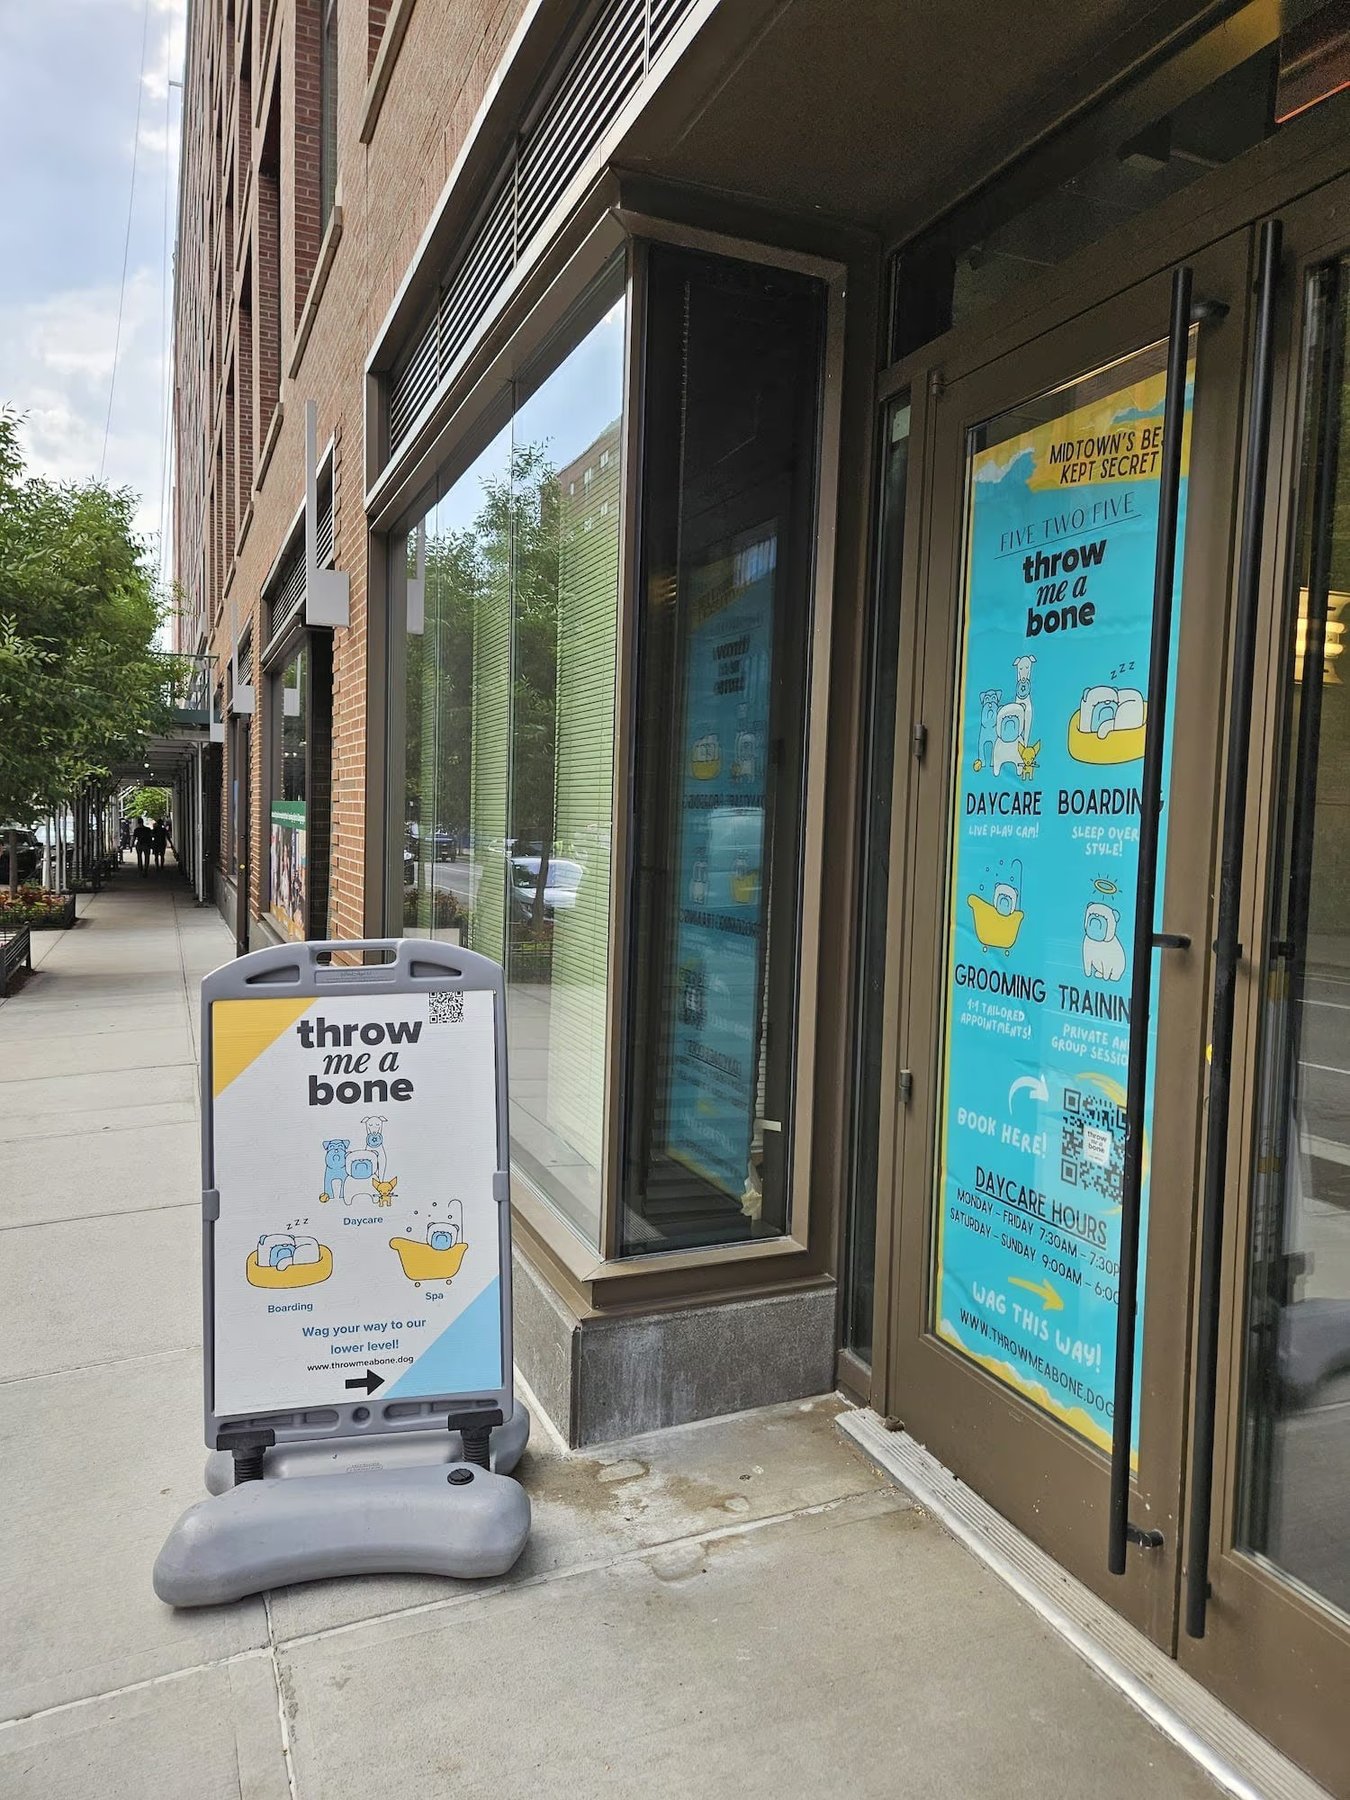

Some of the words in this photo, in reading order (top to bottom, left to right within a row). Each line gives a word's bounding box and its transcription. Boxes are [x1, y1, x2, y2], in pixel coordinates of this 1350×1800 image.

[1050, 431, 1135, 464] MIDTOWN'S
[1141, 426, 1165, 450] BE
[1060, 460, 1095, 484] KEPT
[1100, 451, 1159, 479] SECRET
[1000, 524, 1036, 551] FIVE
[1042, 508, 1085, 538] TWO
[1092, 491, 1135, 523] FIVE
[1022, 539, 1107, 584] throw
[1036, 579, 1066, 606] me
[1072, 575, 1087, 599] a
[1025, 601, 1096, 637] bone
[967, 791, 1042, 815] DAYCARE
[1058, 788, 1164, 815] BOARDIN
[969, 824, 987, 837] LIVE
[990, 824, 1012, 838] PLAY
[1016, 822, 1039, 838] CAM!
[1072, 826, 1104, 840] SLEEP
[1085, 840, 1122, 856] STYLE!
[955, 964, 1046, 1003] GROOMING
[982, 1003, 1025, 1022] TAILORED
[1059, 985, 1132, 1024] TRAININ
[297, 1017, 422, 1049] throw
[960, 1013, 1031, 1040] APPOINTMENTS!
[1063, 1024, 1108, 1045] PRIVATE
[1112, 1036, 1130, 1051] AN
[322, 1052, 370, 1075] me
[379, 1051, 399, 1072] a
[1052, 1036, 1087, 1057] GROUP
[1091, 1047, 1128, 1066] SESSIO
[308, 1075, 414, 1106] bone
[957, 1107, 996, 1136] BOOK
[1002, 1124, 1048, 1159] HERE!
[976, 1166, 1046, 1218] DAYCARE
[1052, 1200, 1107, 1246] HOURS
[343, 1216, 384, 1227] Daycare
[957, 1188, 995, 1216] MONDAY
[1003, 1210, 1034, 1233] FRIDAY
[1039, 1227, 1078, 1258] 7:30AM
[1090, 1251, 1120, 1277] 7:30P
[950, 1207, 992, 1238] SATURDAY
[1001, 1231, 1036, 1262] SUNDAY
[1042, 1254, 1082, 1286] 9:00AM
[1095, 1281, 1119, 1305] 6:00
[268, 1303, 313, 1313] Boarding
[425, 1291, 444, 1302] Spa
[302, 1326, 330, 1338] Wag
[332, 1323, 360, 1336] your
[363, 1321, 387, 1333] way
[391, 1319, 403, 1330] to
[406, 1318, 427, 1329] our
[972, 1281, 1007, 1315] WAG
[1012, 1303, 1049, 1341] THIS
[1055, 1329, 1101, 1374] WAY!
[330, 1343, 364, 1355] lower
[367, 1340, 399, 1352] level!
[307, 1355, 414, 1372] www.throwmeabone.dog
[960, 1308, 1114, 1418] WWW.THROWMEABONE.DOG
